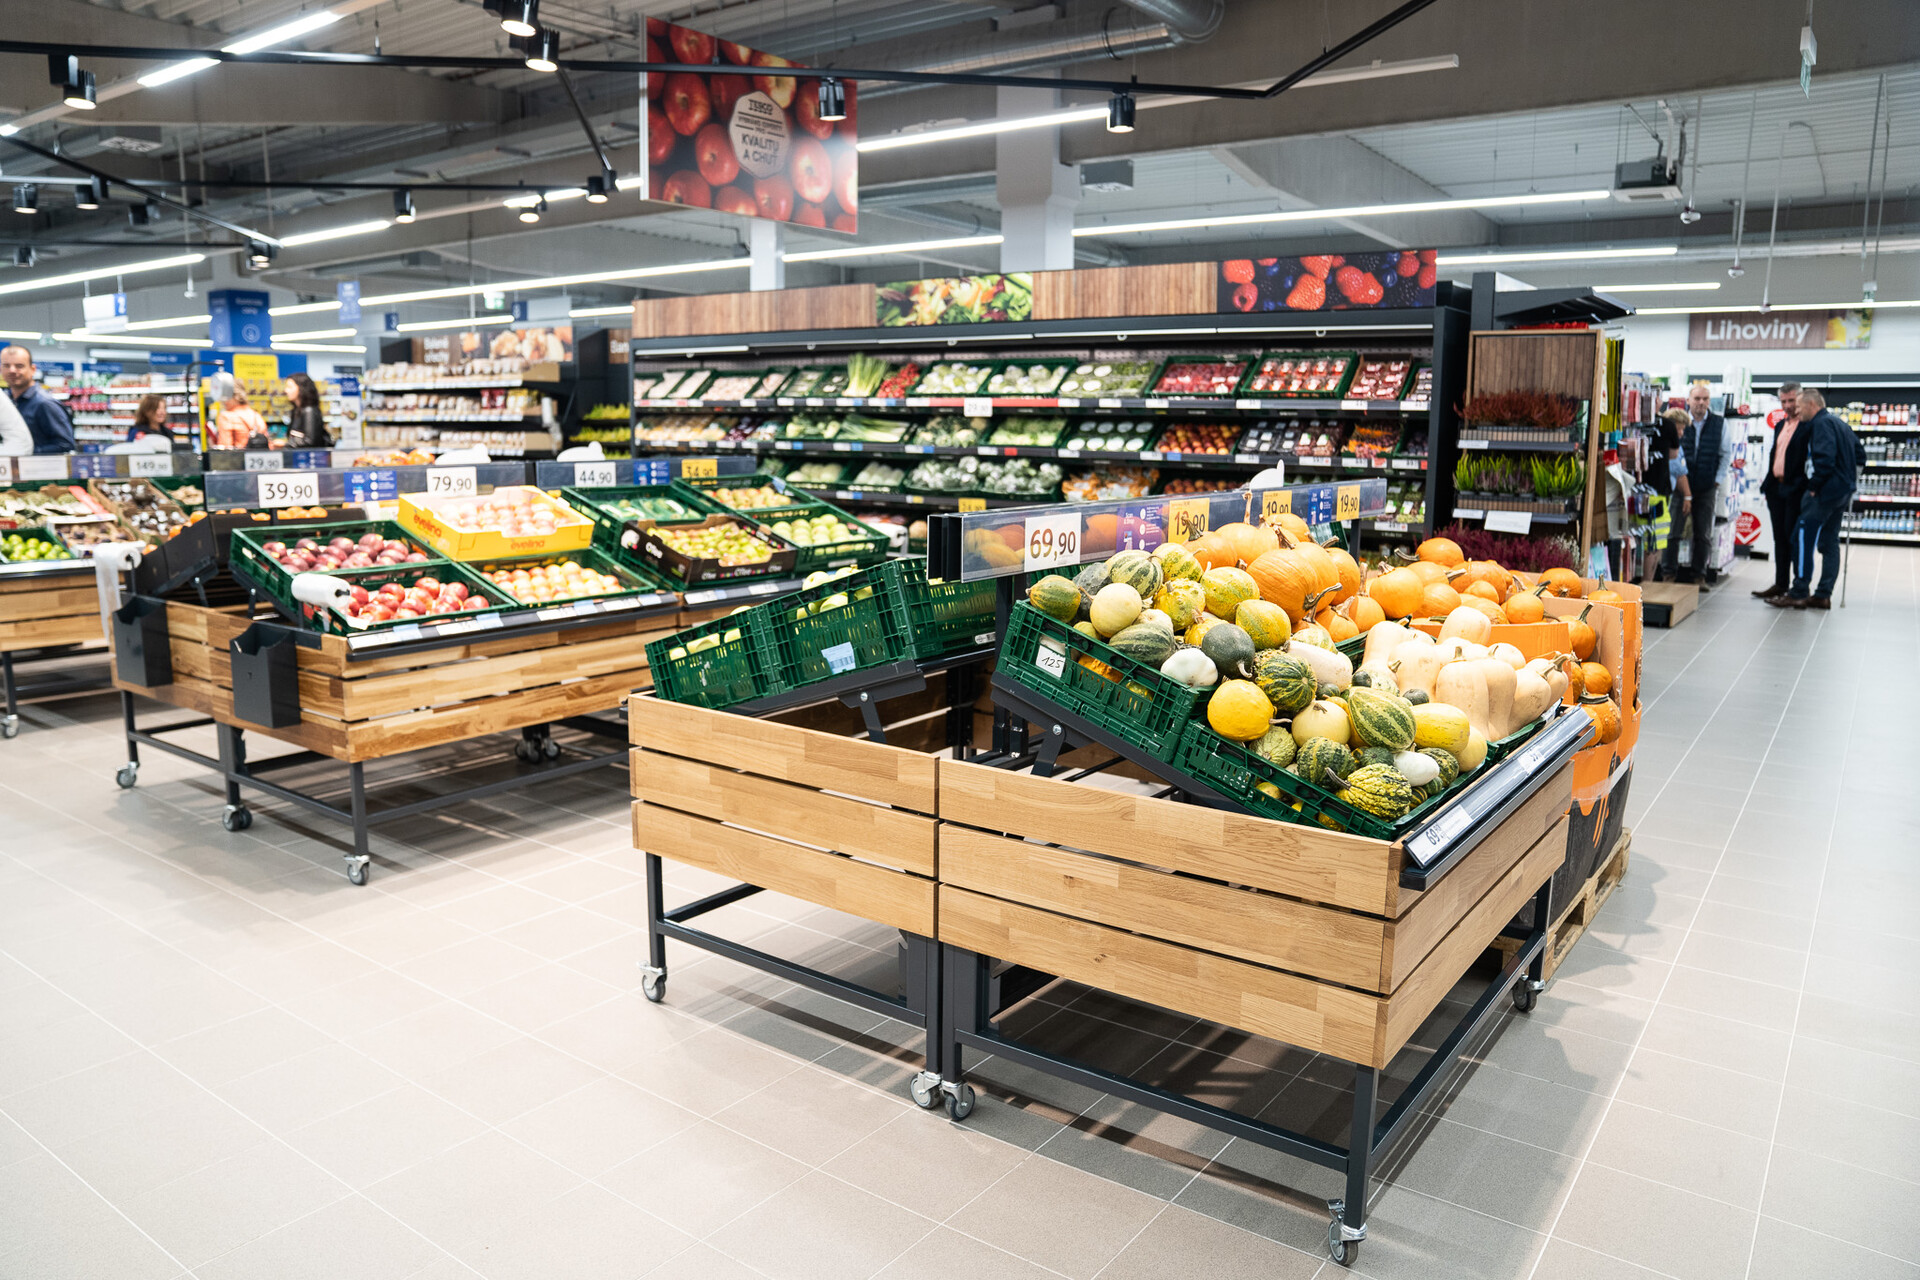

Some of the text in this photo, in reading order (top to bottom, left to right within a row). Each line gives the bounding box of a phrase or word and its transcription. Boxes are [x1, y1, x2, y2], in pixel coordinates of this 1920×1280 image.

[741, 133, 779, 152] KVALITU
[743, 149, 750, 161] A
[1705, 319, 1811, 345] Lihoviny
[432, 476, 472, 492] 79,90
[579, 470, 612, 486] 44,90
[264, 482, 313, 501] 39,90
[1266, 500, 1289, 517] 1990
[1340, 494, 1358, 515] 19,90
[1174, 510, 1206, 536] 1990
[1030, 528, 1077, 562] 69,90
[1041, 656, 1066, 669] 125
[1425, 828, 1441, 846] 69
